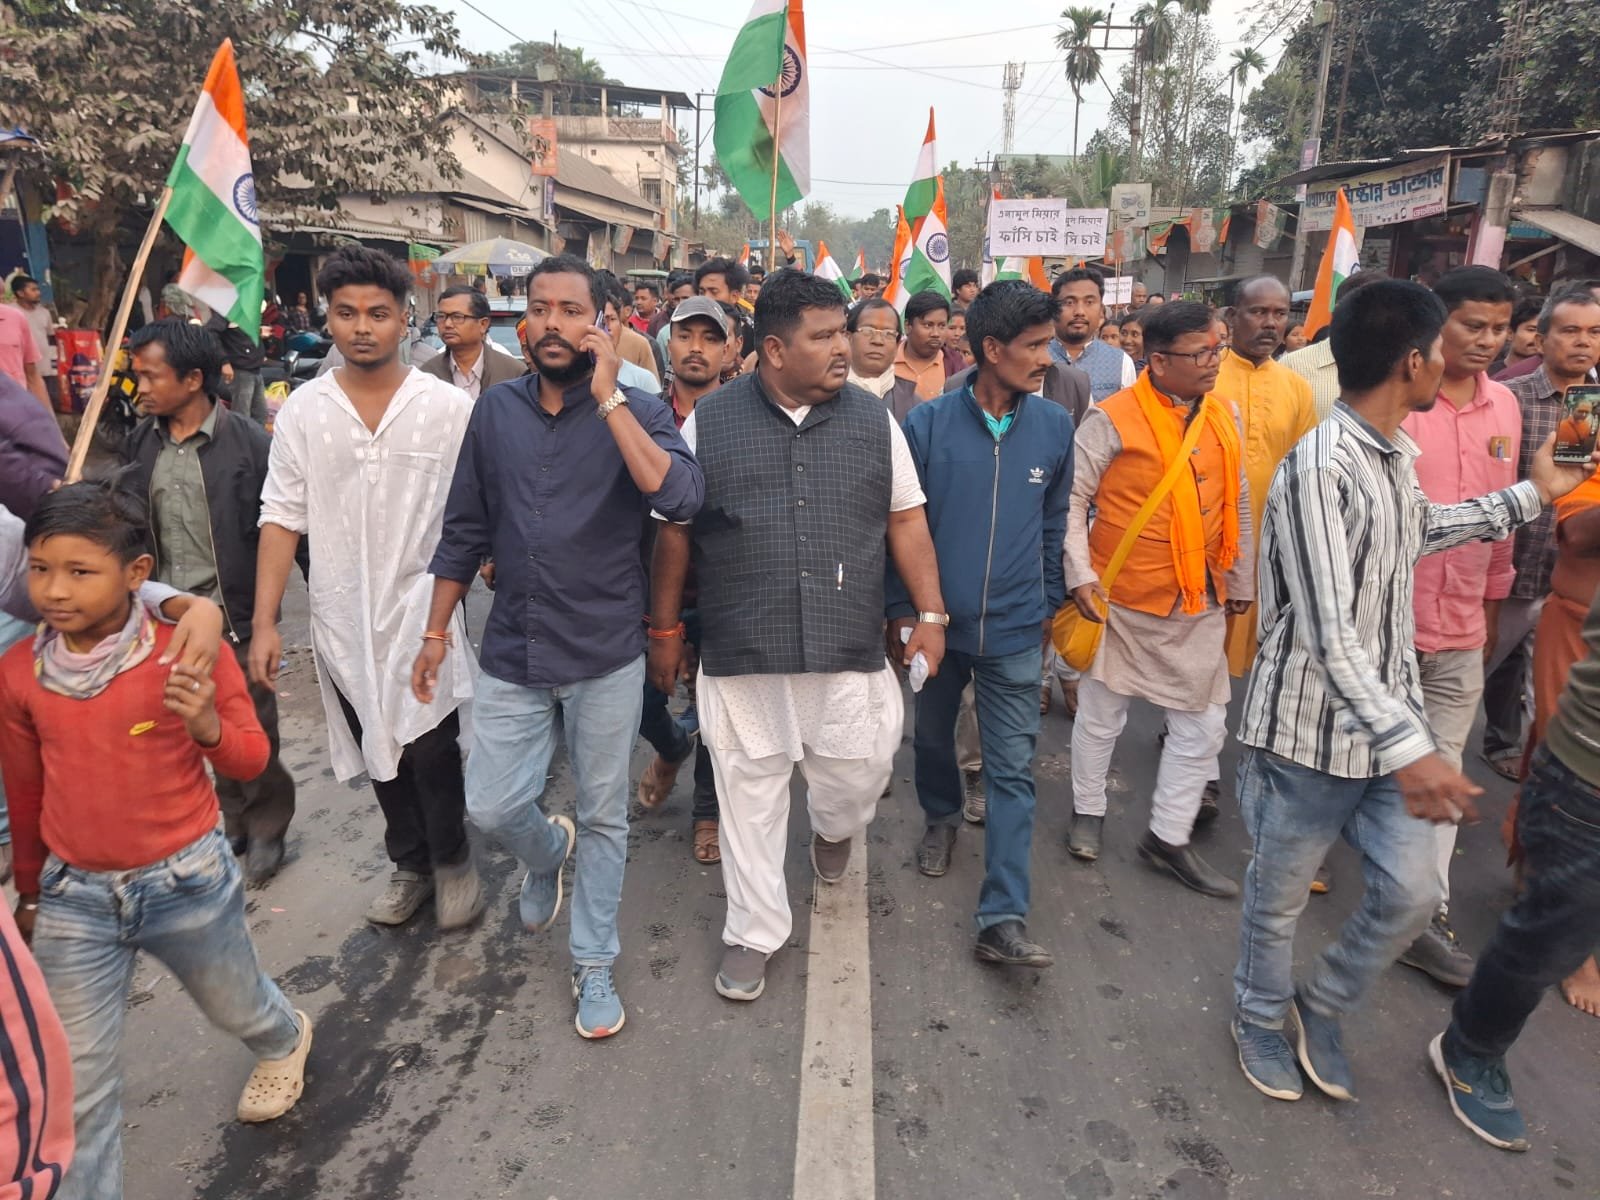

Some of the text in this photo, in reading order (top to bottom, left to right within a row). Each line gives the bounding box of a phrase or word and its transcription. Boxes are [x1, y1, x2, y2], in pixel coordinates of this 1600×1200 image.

[999, 225, 1059, 243] ফাঁসি চাই
[1081, 231, 1101, 245] চাই
